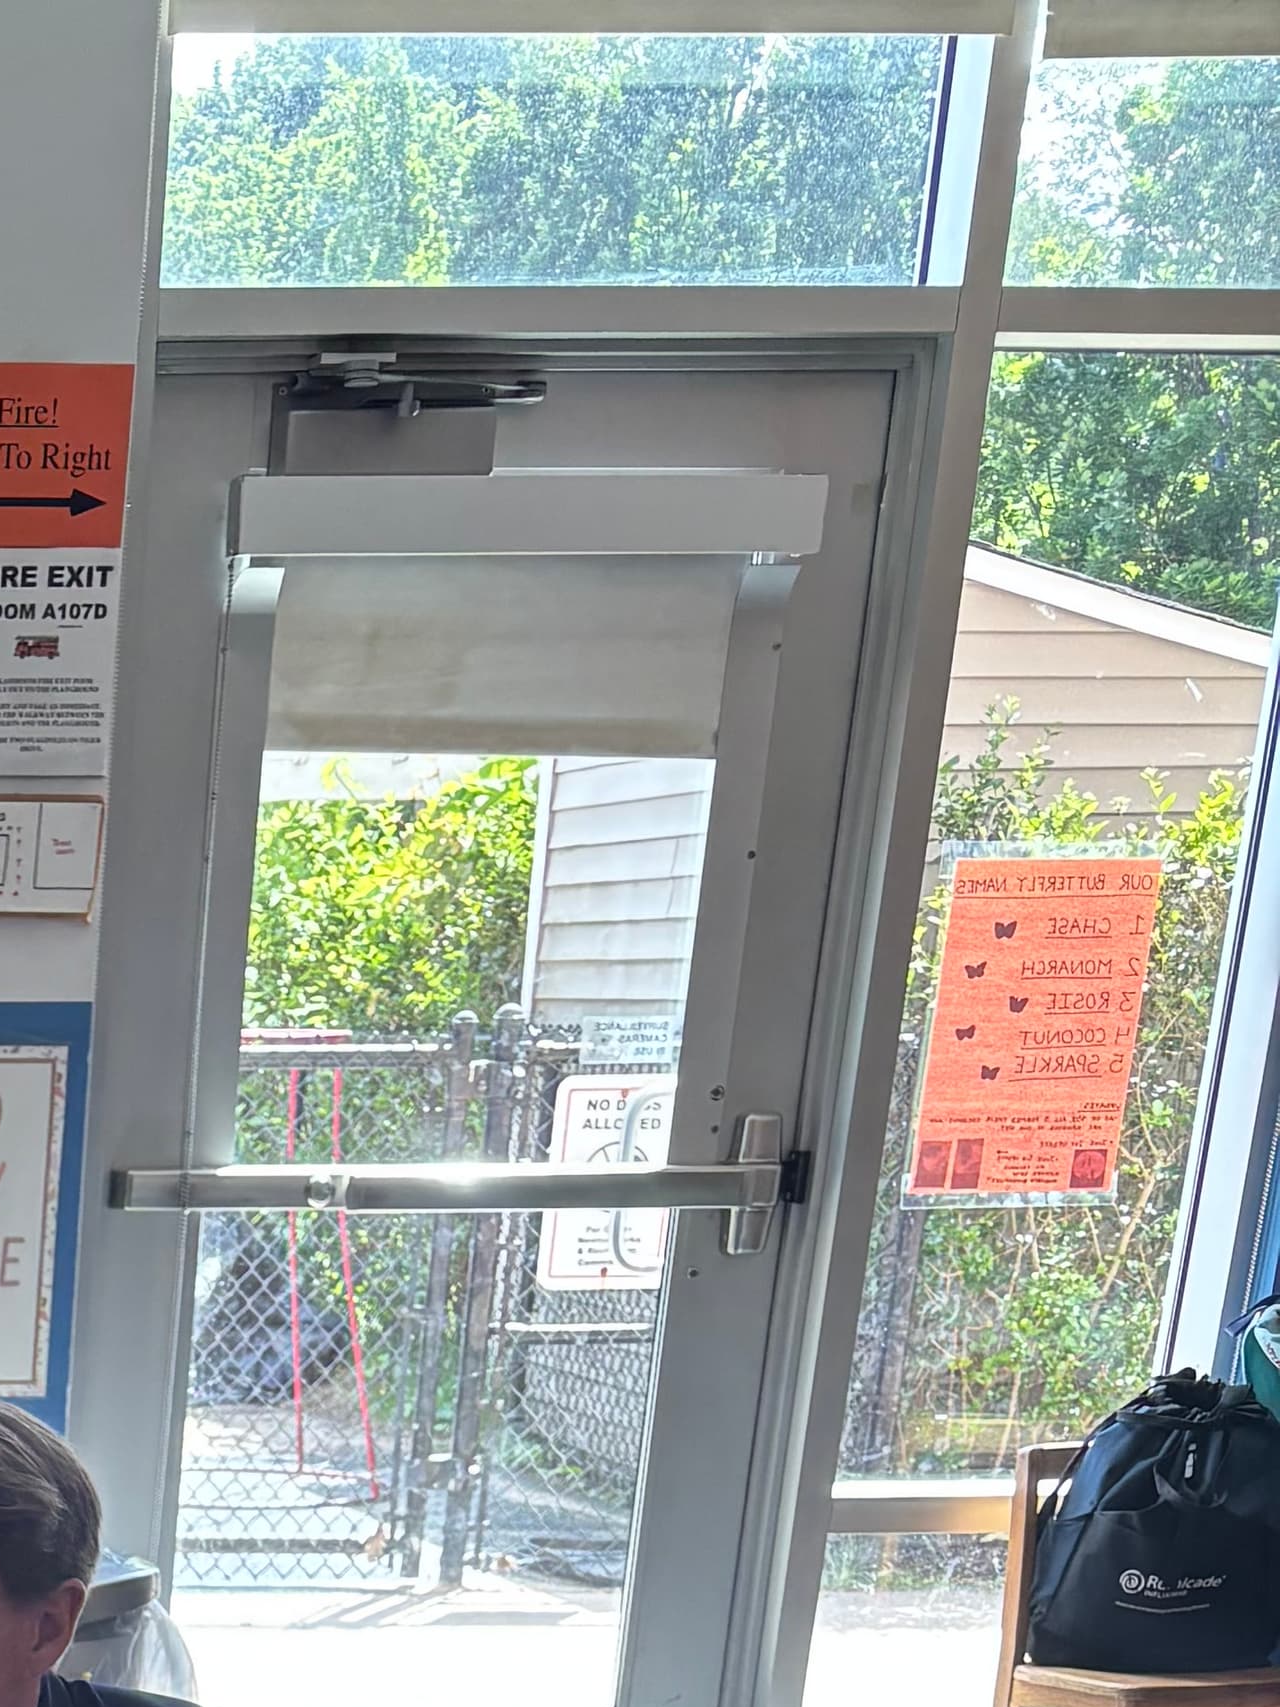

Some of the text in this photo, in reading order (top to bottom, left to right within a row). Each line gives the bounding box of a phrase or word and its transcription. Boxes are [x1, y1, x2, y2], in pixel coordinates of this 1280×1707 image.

[0, 443, 32, 470] To
[41, 443, 112, 478] Right
[47, 565, 114, 588] EXIT
[42, 603, 107, 620] A107D
[586, 1099, 611, 1111] NO
